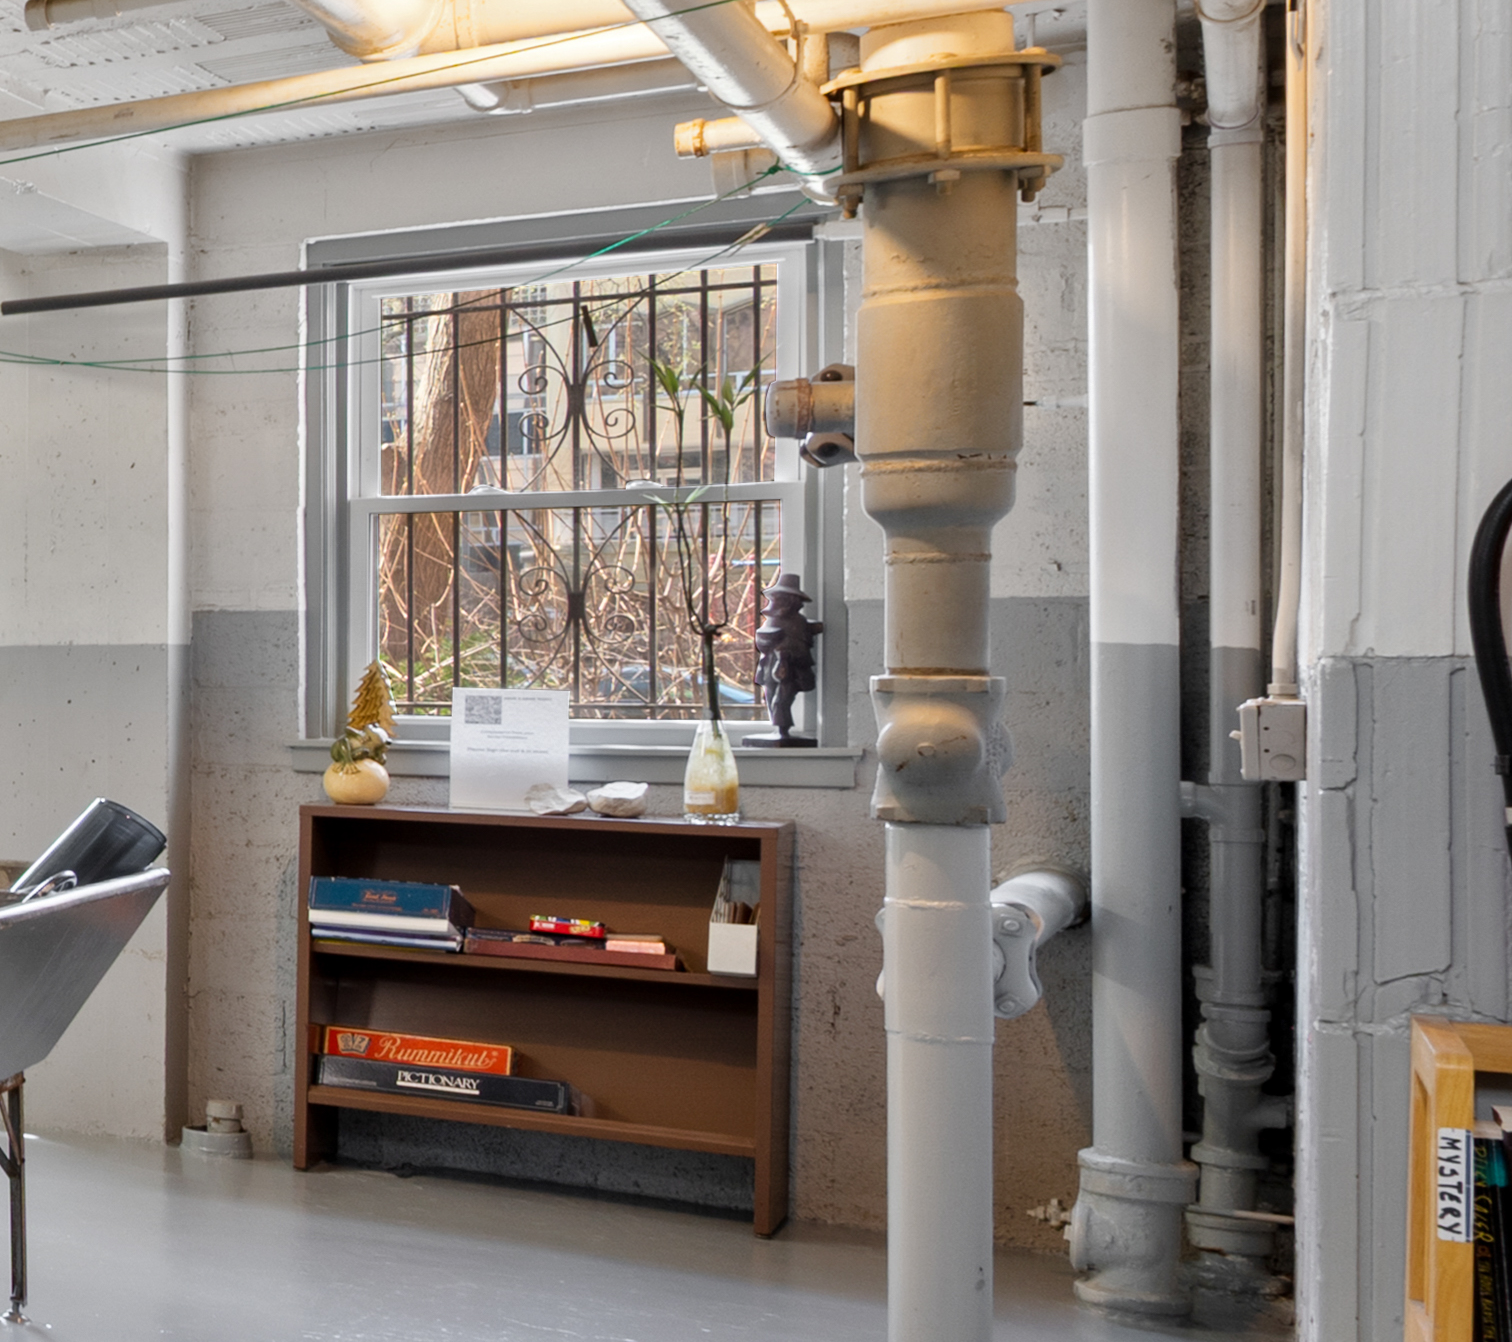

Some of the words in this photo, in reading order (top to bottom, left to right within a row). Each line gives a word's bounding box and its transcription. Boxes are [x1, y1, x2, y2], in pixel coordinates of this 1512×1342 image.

[375, 1036, 498, 1068] Rummikub
[397, 1069, 480, 1091] PICTIONARY
[1438, 1136, 1463, 1236] MYSTERY
